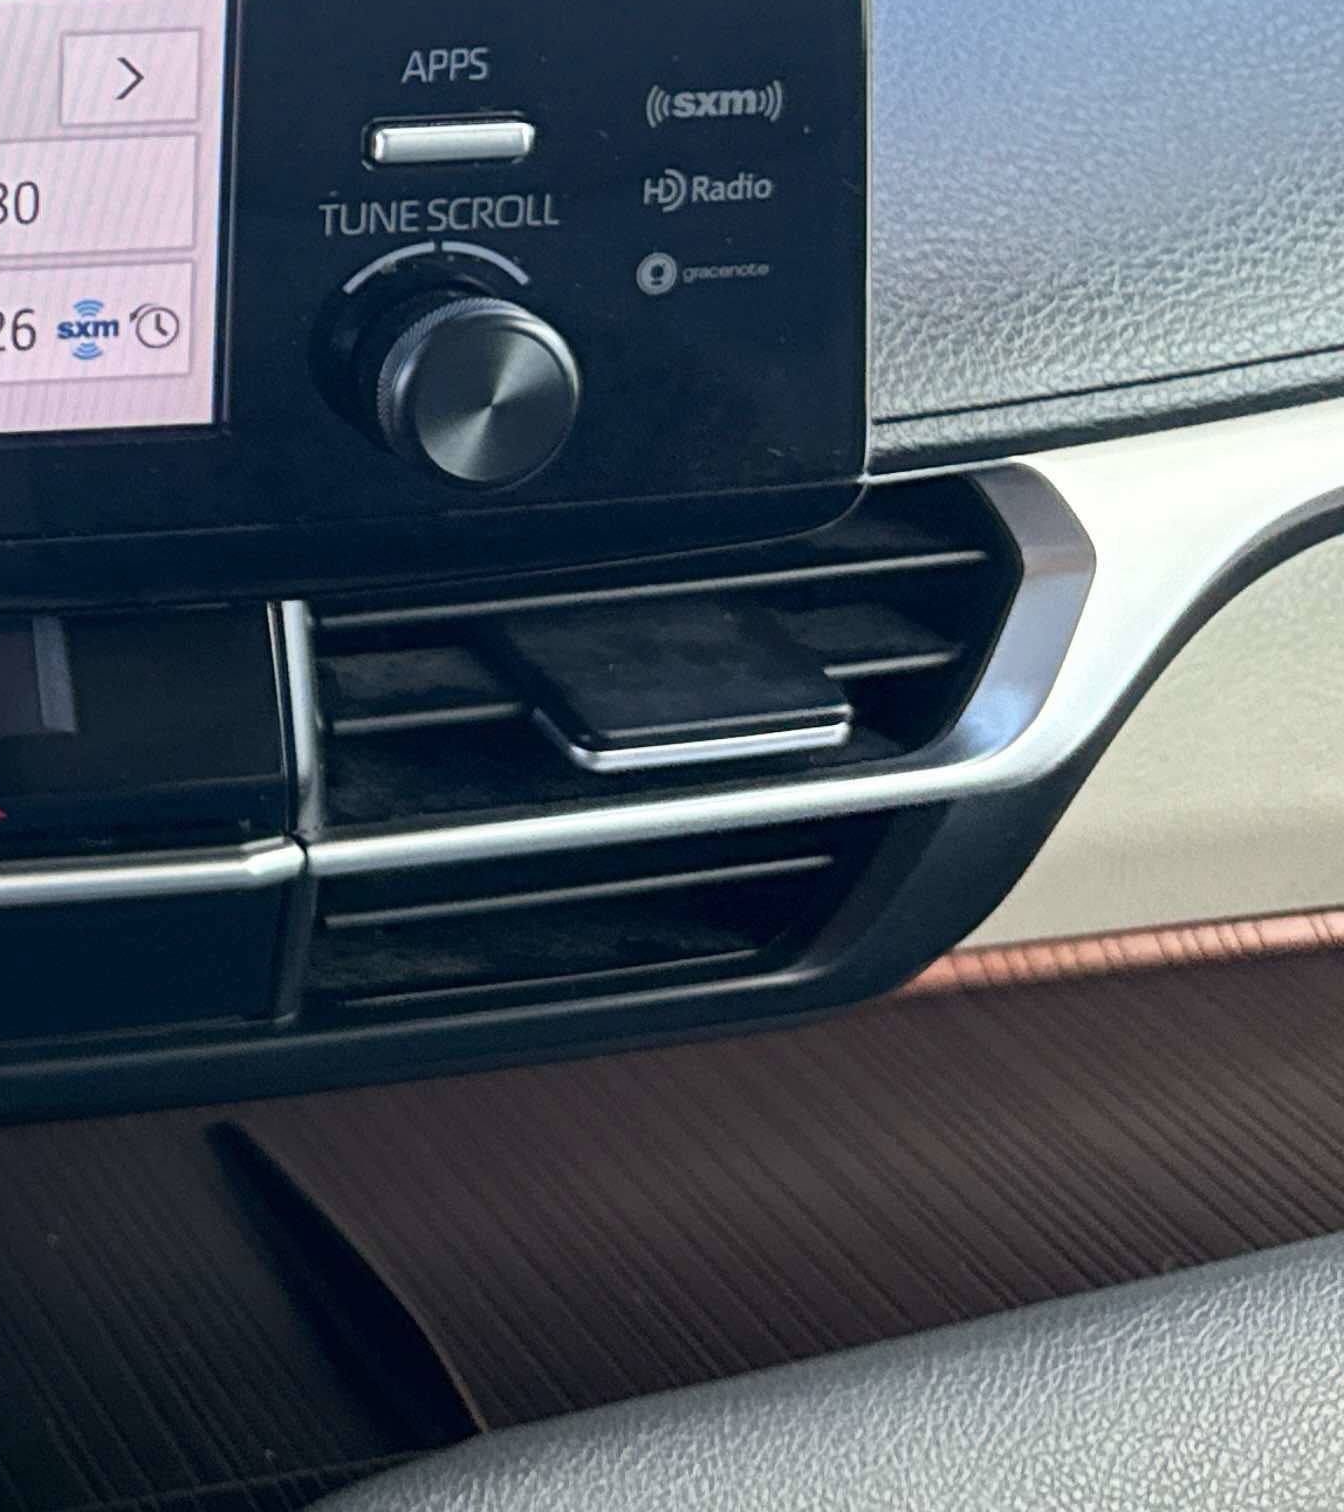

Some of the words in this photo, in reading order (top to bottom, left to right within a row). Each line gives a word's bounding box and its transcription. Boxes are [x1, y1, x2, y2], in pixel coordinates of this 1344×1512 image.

[400, 45, 490, 84] APPS
[669, 87, 762, 120] sxm
[691, 173, 773, 204] Radio
[319, 199, 420, 237] TUNE
[426, 193, 560, 233] SCROLL
[682, 260, 770, 283] gracenote
[56, 317, 120, 342] sxm
